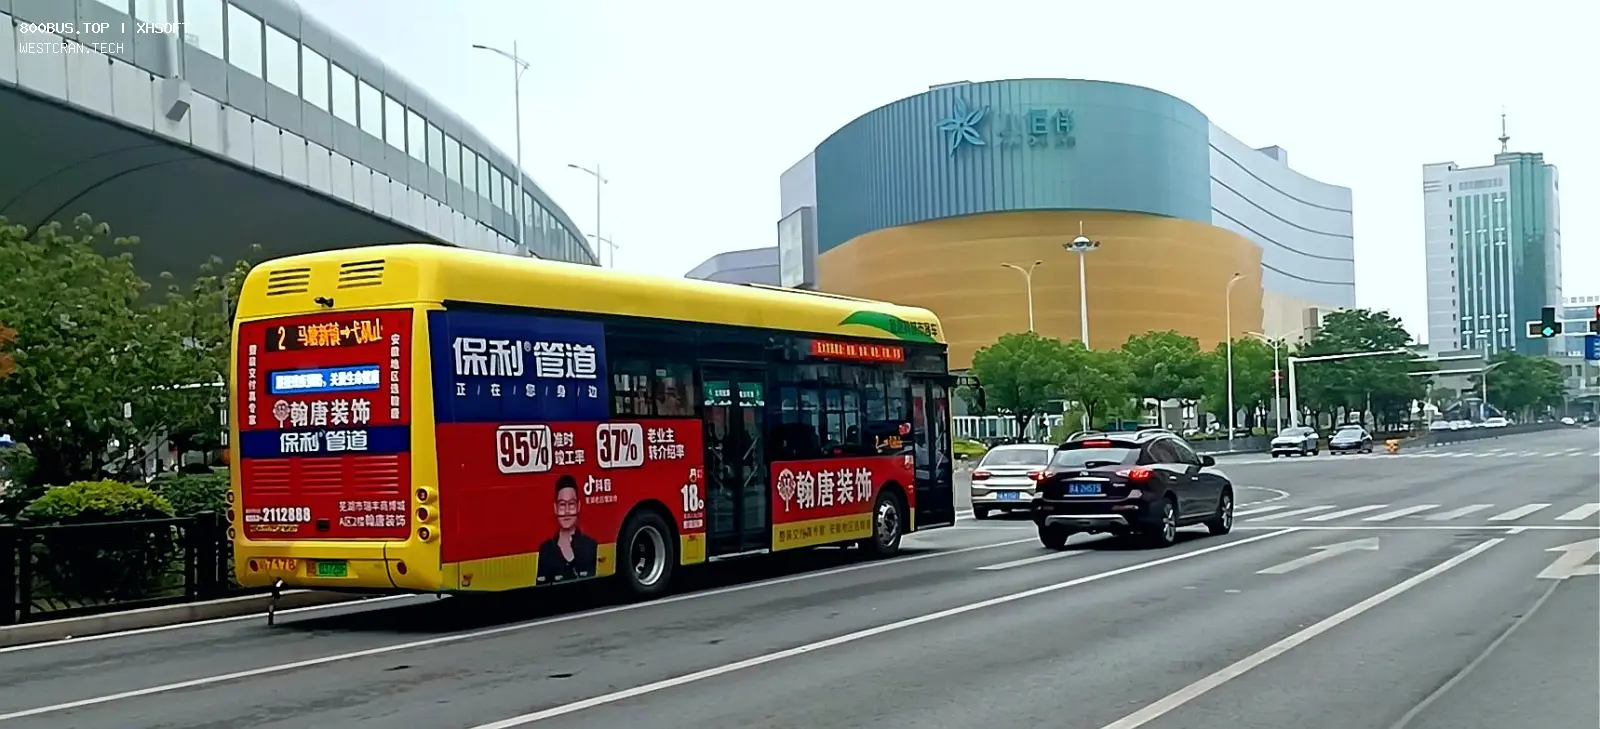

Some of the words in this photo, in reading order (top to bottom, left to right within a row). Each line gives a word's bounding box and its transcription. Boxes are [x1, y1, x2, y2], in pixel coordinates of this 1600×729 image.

[278, 326, 286, 350] 2
[290, 398, 371, 427] 翰唐装饰
[553, 431, 574, 447] 准时
[647, 428, 675, 443] 老业主
[499, 431, 549, 467] 95%
[599, 429, 637, 463] 37%
[648, 444, 685, 460] 转介绍率
[554, 449, 586, 465] 竣工率
[595, 478, 612, 492] 抖音
[796, 467, 873, 509] 翰唐装饰
[262, 507, 311, 522] 2112888
